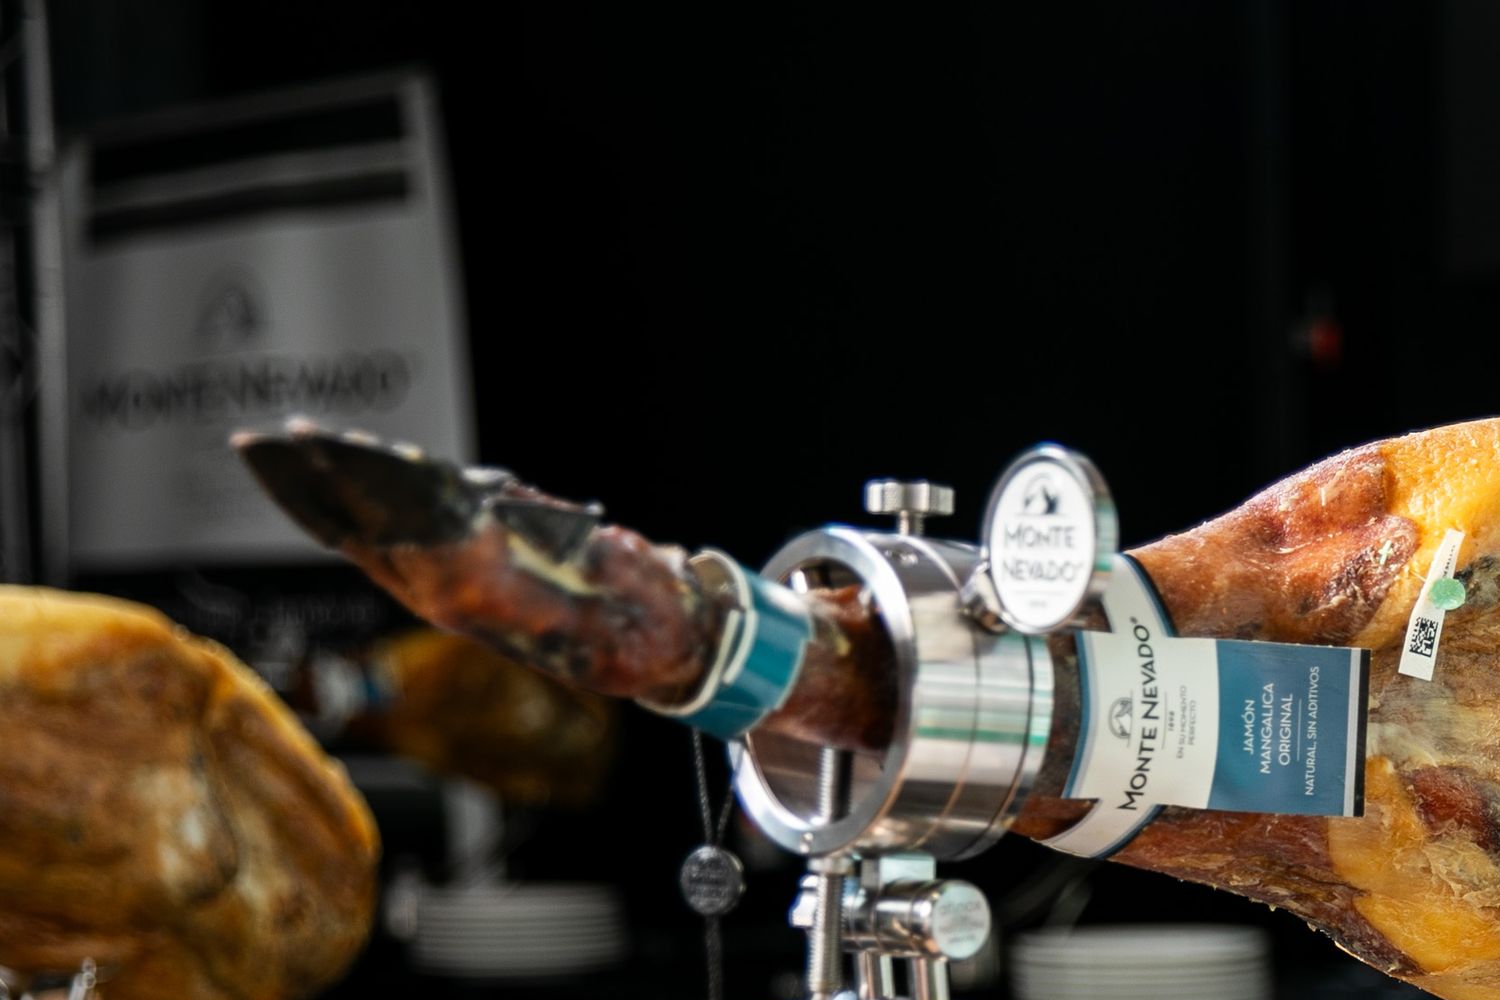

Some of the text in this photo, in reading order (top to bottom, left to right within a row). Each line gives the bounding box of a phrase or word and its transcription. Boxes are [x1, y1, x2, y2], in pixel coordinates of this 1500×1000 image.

[1003, 525, 1077, 550] MONTE
[1306, 665, 1320, 719] ADITIVOS
[1176, 685, 1188, 760] EN SU MOMENTO
[1187, 699, 1198, 745] PERFECTO
[1241, 699, 1256, 755] JAMÓN
[1260, 682, 1275, 775] MANGALICA
[1278, 693, 1294, 767] ORIGINAL
[1305, 720, 1318, 740] SIN
[1117, 727, 1157, 811] MONTE
